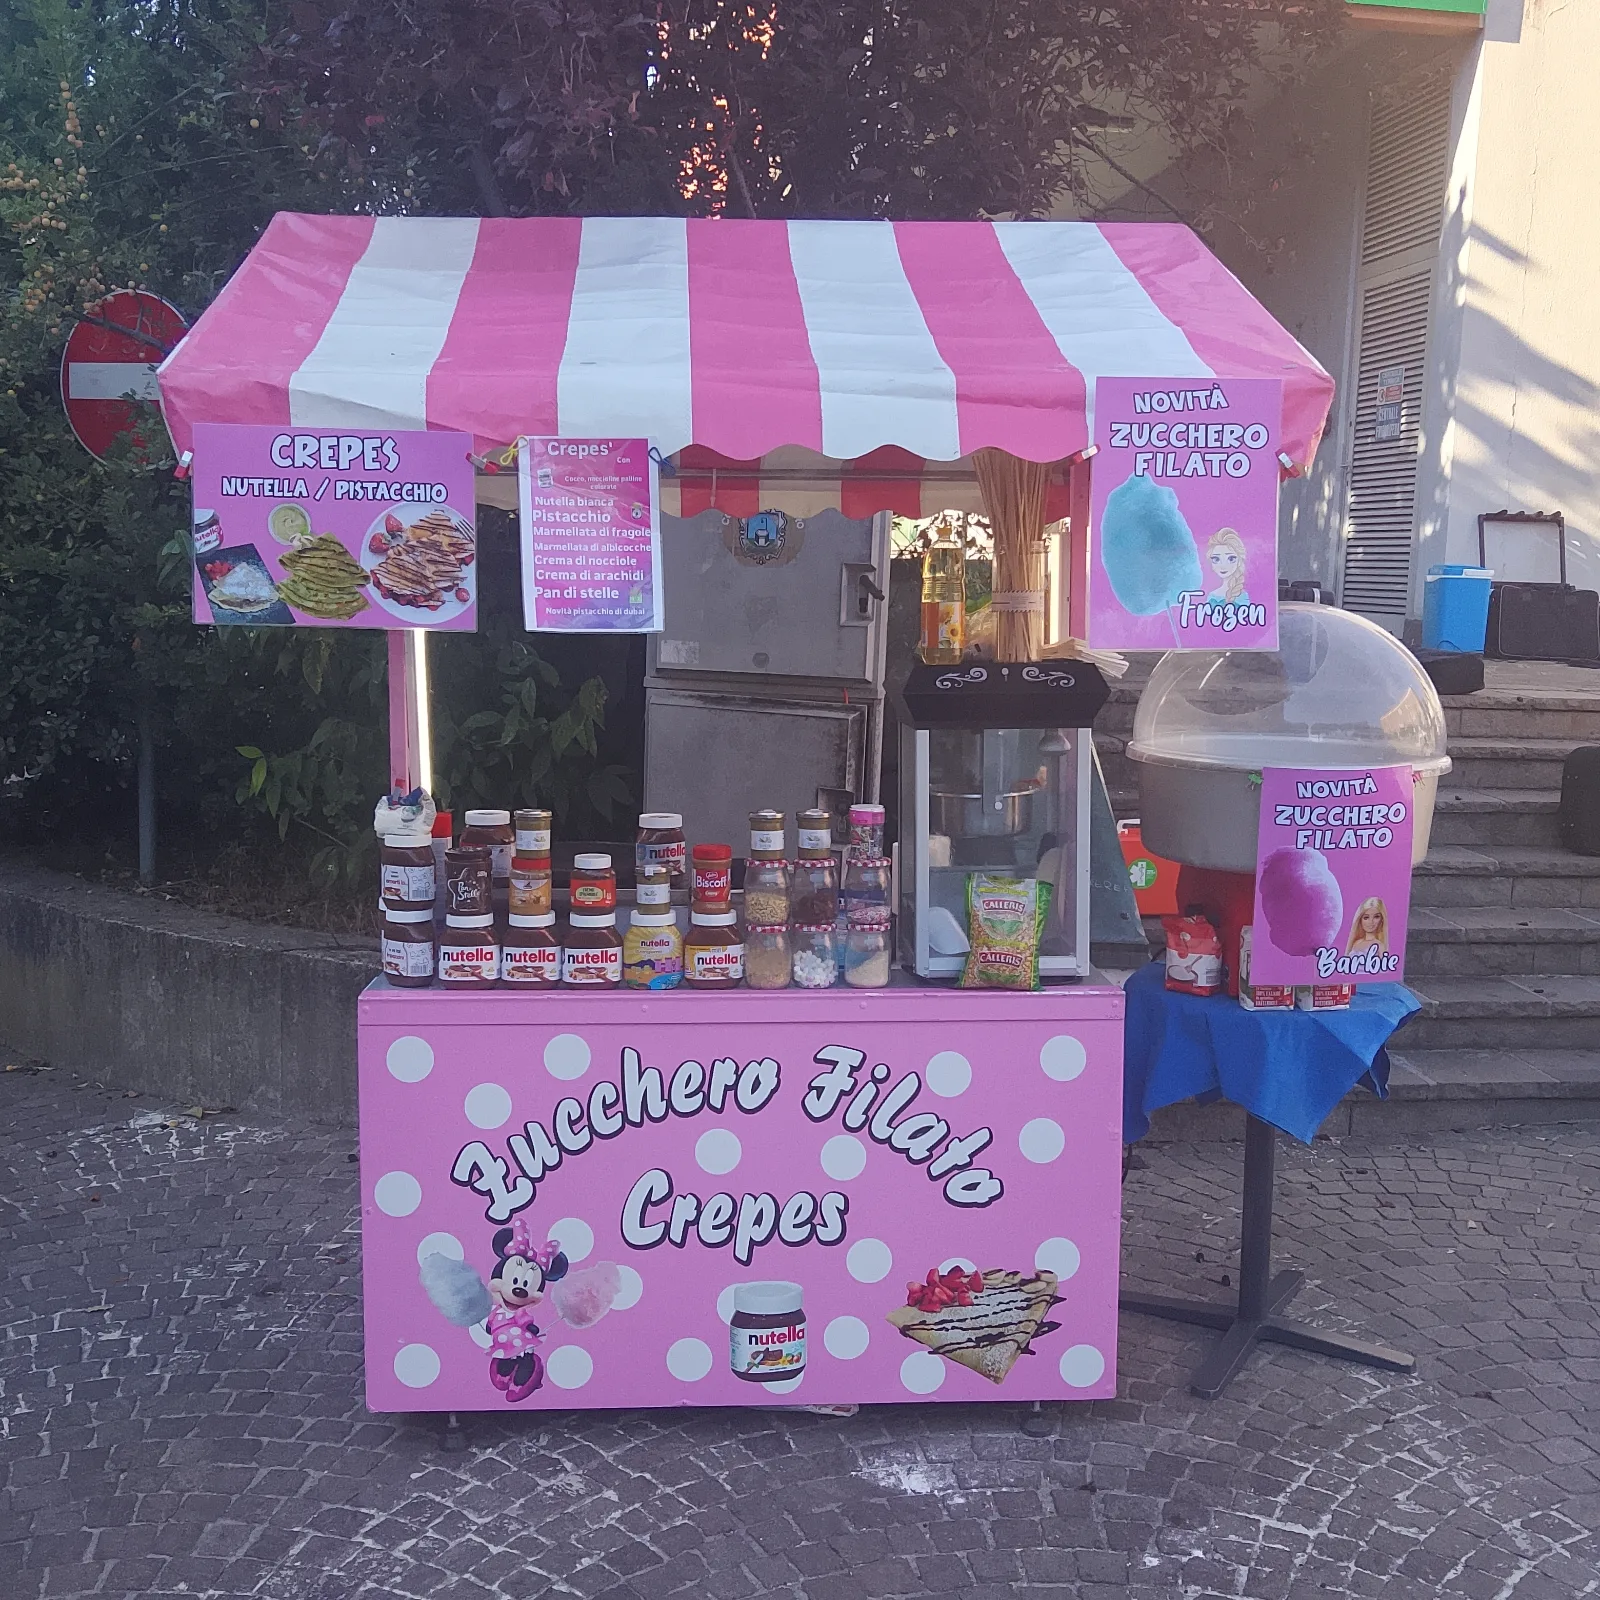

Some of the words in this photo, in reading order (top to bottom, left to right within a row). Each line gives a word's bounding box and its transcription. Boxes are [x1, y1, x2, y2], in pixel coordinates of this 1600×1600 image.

[1133, 383, 1229, 414] NOVITÀ
[1110, 422, 1269, 449] ZUCCHERO
[270, 433, 400, 472] CREPES
[1134, 452, 1251, 478] FILATO
[221, 476, 309, 498] NUTELLA
[314, 477, 331, 500] /
[335, 480, 448, 503] PISTACCHIO
[534, 496, 575, 507] Nutella
[577, 496, 614, 507] bianca
[533, 509, 611, 523] Pistacchio
[533, 526, 597, 537] Marmellata
[600, 526, 609, 537] di
[612, 526, 651, 539] fragole
[534, 543, 588, 552] Marmellata
[590, 543, 600, 552] di
[534, 555, 573, 566] Crema
[575, 555, 586, 566] di
[588, 555, 637, 566] nocciole
[536, 569, 577, 581] Crema
[580, 569, 591, 581] di
[594, 569, 644, 581] arachidi
[535, 586, 561, 599] Pan
[564, 586, 577, 599] di
[580, 586, 619, 599] stelle
[1178, 590, 1267, 632] Frozen
[1296, 773, 1378, 799] NOVITÀ
[1274, 802, 1407, 827] ZUCCHERO
[1296, 827, 1393, 850] FILATO
[696, 876, 727, 888] Biscoff
[641, 939, 670, 947] nutella
[442, 948, 494, 963] nutella
[505, 949, 556, 963] nutella
[567, 950, 618, 964] nutella
[697, 953, 738, 965] nutella
[1315, 943, 1399, 978] Barbie
[450, 1046, 781, 1223] Zucchero
[801, 1043, 1005, 1207] Filato
[620, 1166, 850, 1266] Crepes
[748, 1325, 805, 1346] nutella
